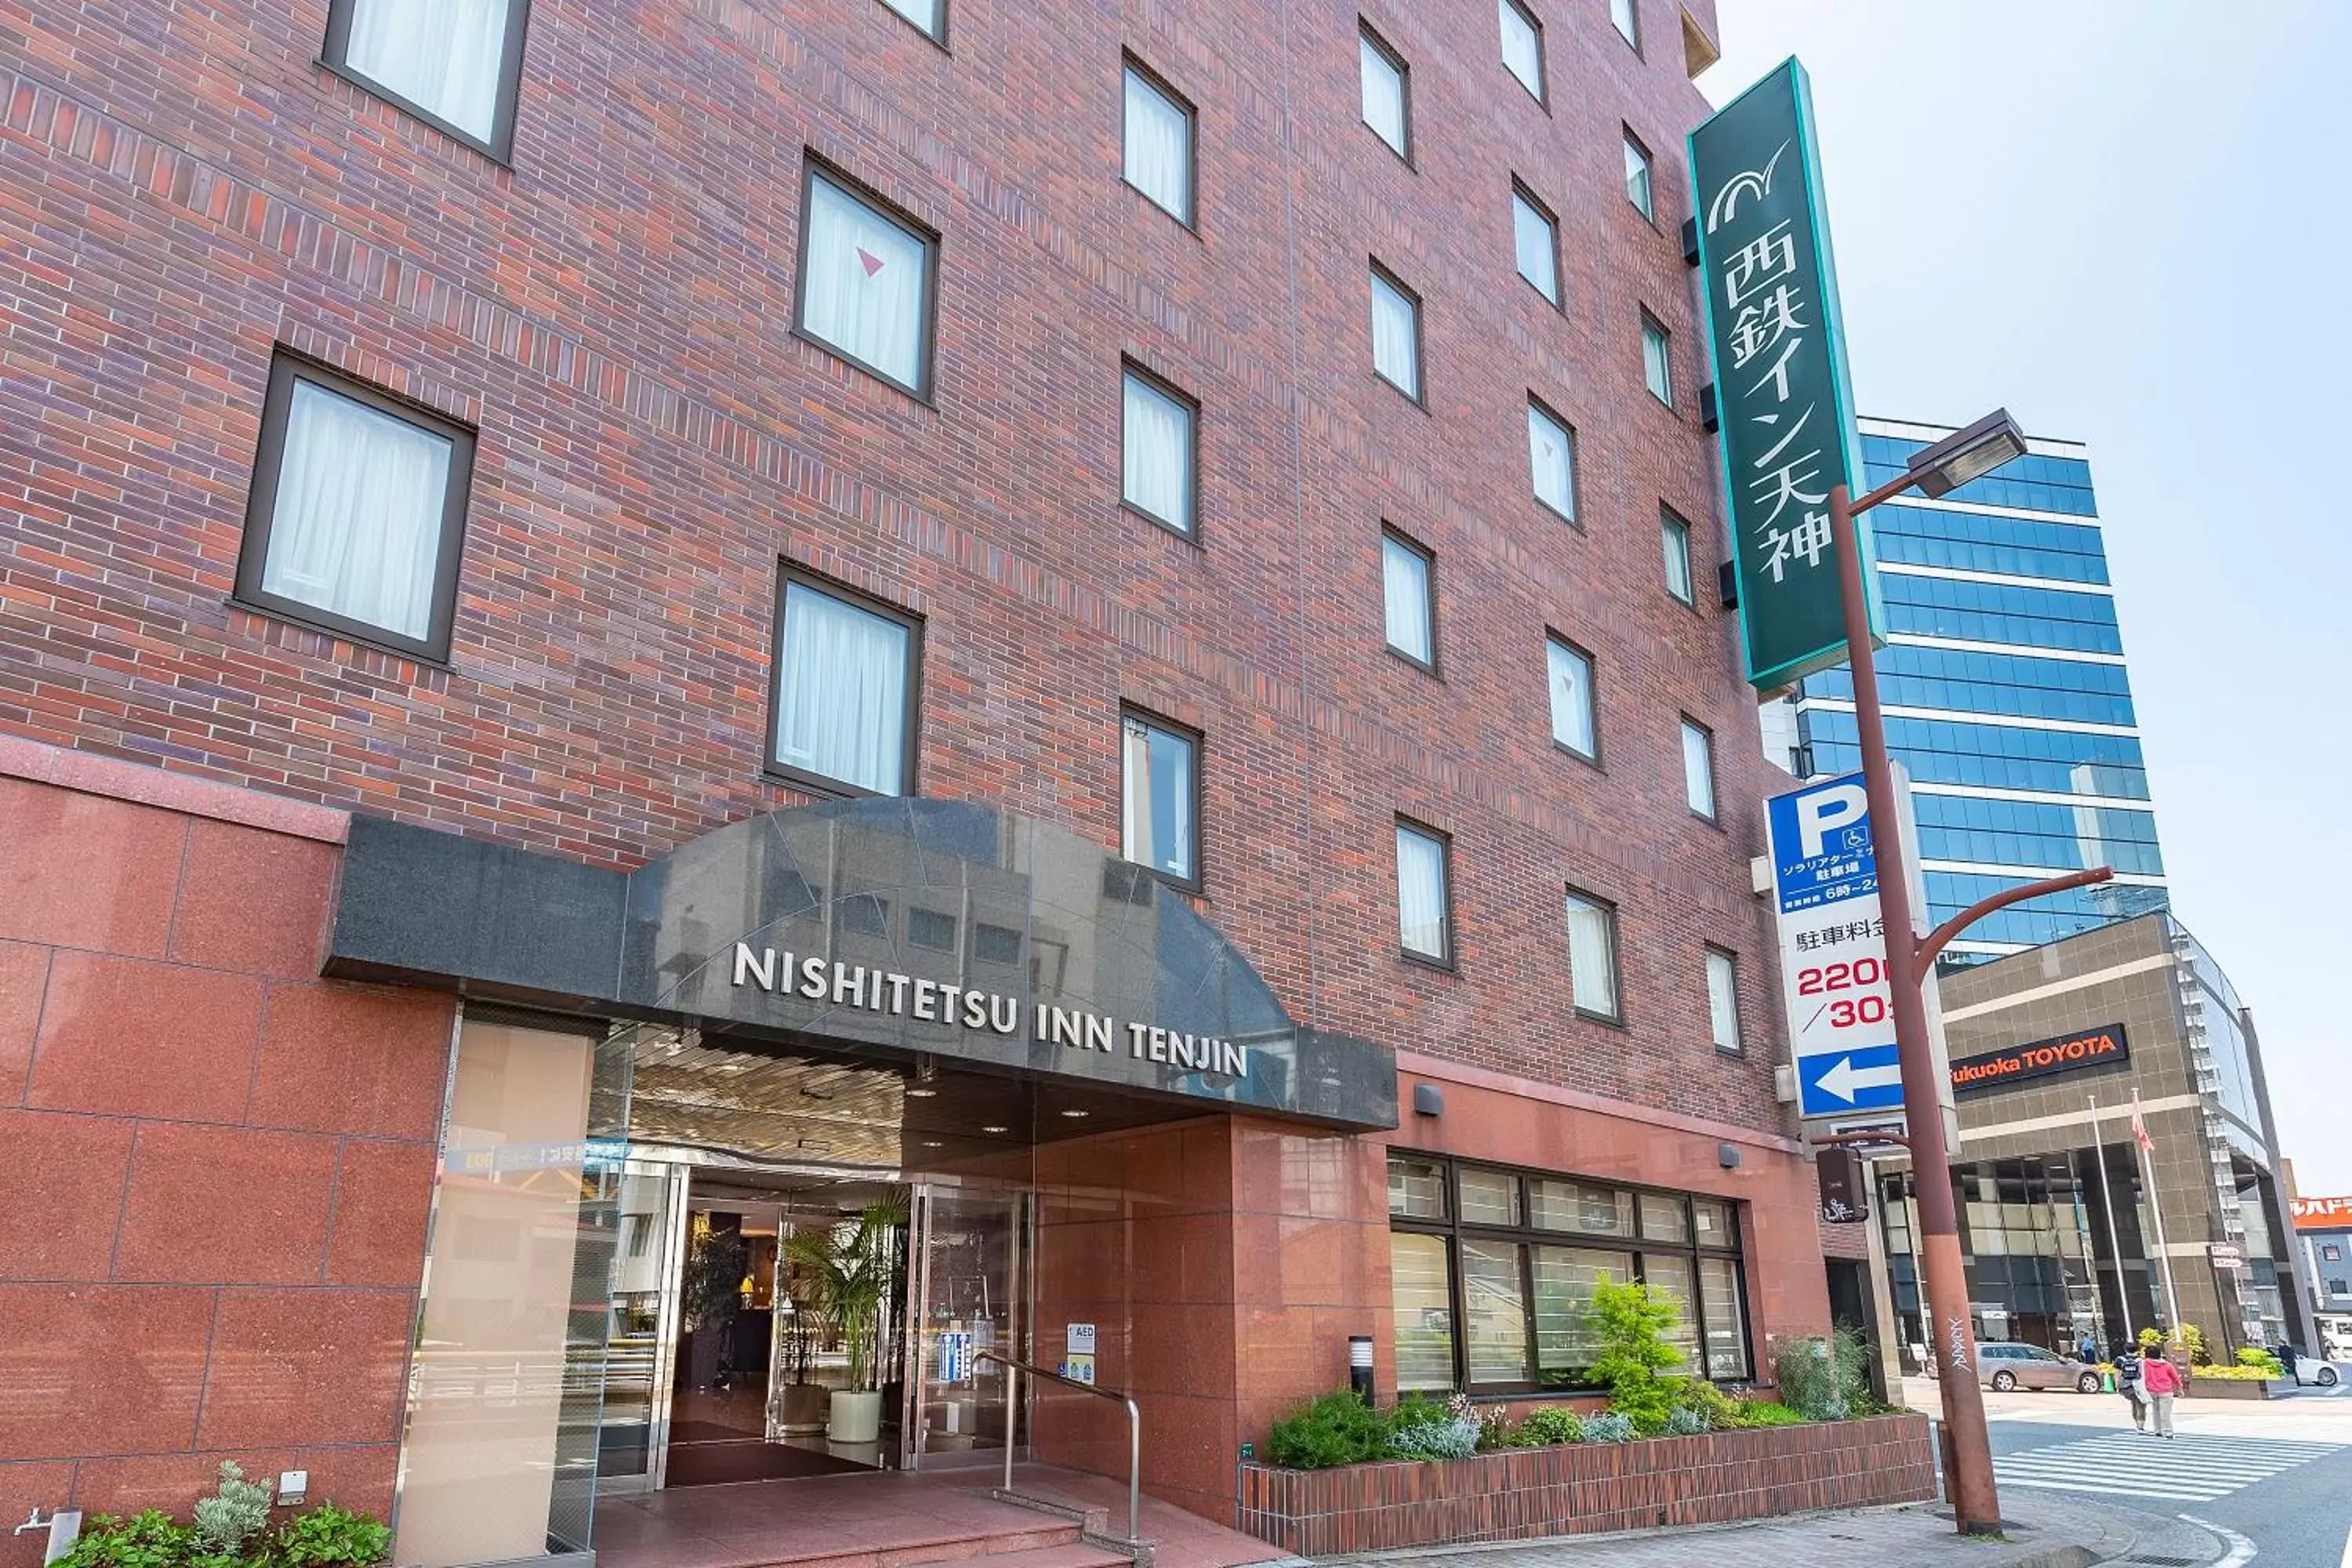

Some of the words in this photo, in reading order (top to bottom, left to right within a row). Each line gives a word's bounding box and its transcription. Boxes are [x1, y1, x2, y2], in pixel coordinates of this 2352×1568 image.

[1723, 219, 1832, 584] 西鉄イン天神
[1796, 784, 1867, 859] P
[1798, 957, 1890, 996] 220
[733, 942, 1017, 1033] NISHITETSU
[1035, 1004, 1113, 1052] INN
[1127, 1022, 1247, 1078] TENJIN
[1802, 995, 1894, 1033] /30
[2021, 1034, 2117, 1068] TOYOTA
[1076, 1327, 1094, 1337] AED
